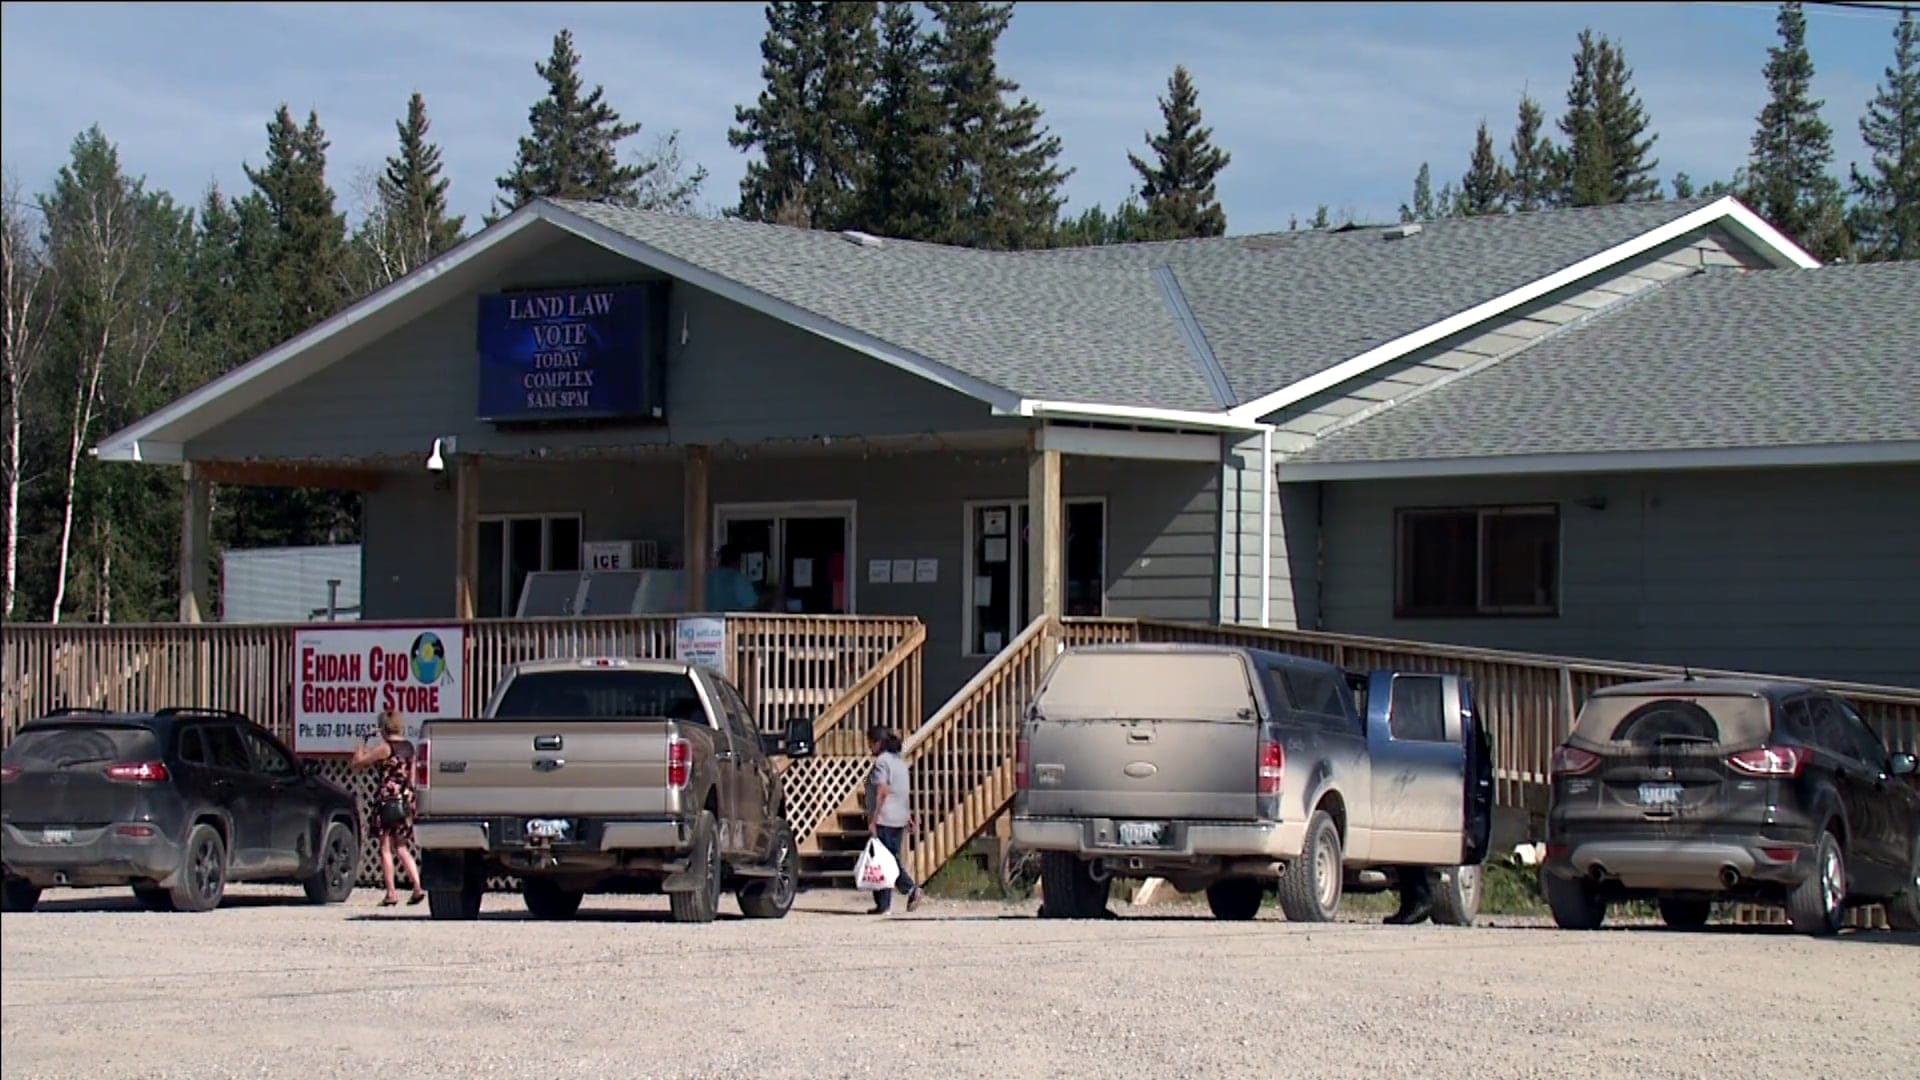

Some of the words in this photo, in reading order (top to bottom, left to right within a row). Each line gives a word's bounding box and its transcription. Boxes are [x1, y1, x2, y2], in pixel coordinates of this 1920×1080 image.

[510, 296, 564, 319] LAND
[569, 293, 613, 316] LAW
[533, 323, 587, 346] VOTE
[534, 352, 581, 369] TODAY
[524, 370, 593, 389] COMPLEX
[593, 553, 620, 569] ICE
[302, 647, 361, 683] EHDAH
[369, 646, 409, 683] CHO
[302, 683, 377, 714] GROCERY
[383, 682, 440, 714] STORE
[299, 723, 314, 737] Ph:
